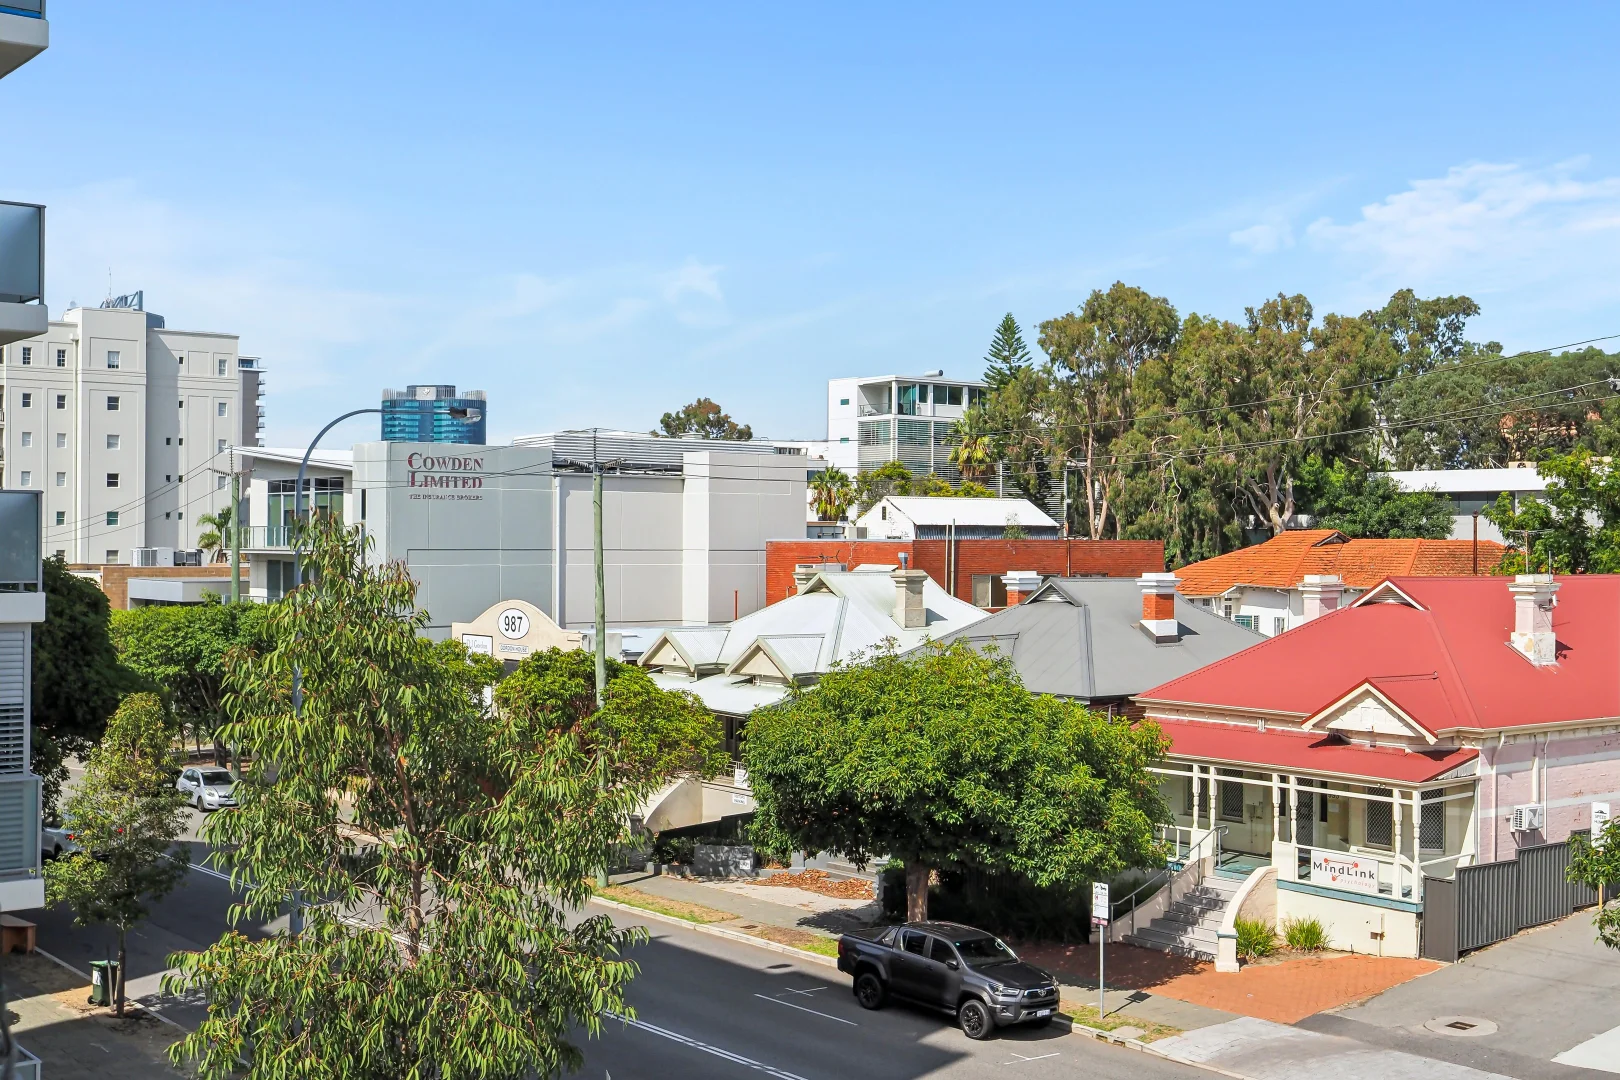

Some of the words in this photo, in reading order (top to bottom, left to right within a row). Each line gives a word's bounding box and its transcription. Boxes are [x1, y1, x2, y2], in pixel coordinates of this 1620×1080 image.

[408, 452, 484, 471] COWDEN
[409, 471, 483, 488] LIMITED
[504, 616, 522, 632] 987
[1313, 861, 1375, 880] MindLink
